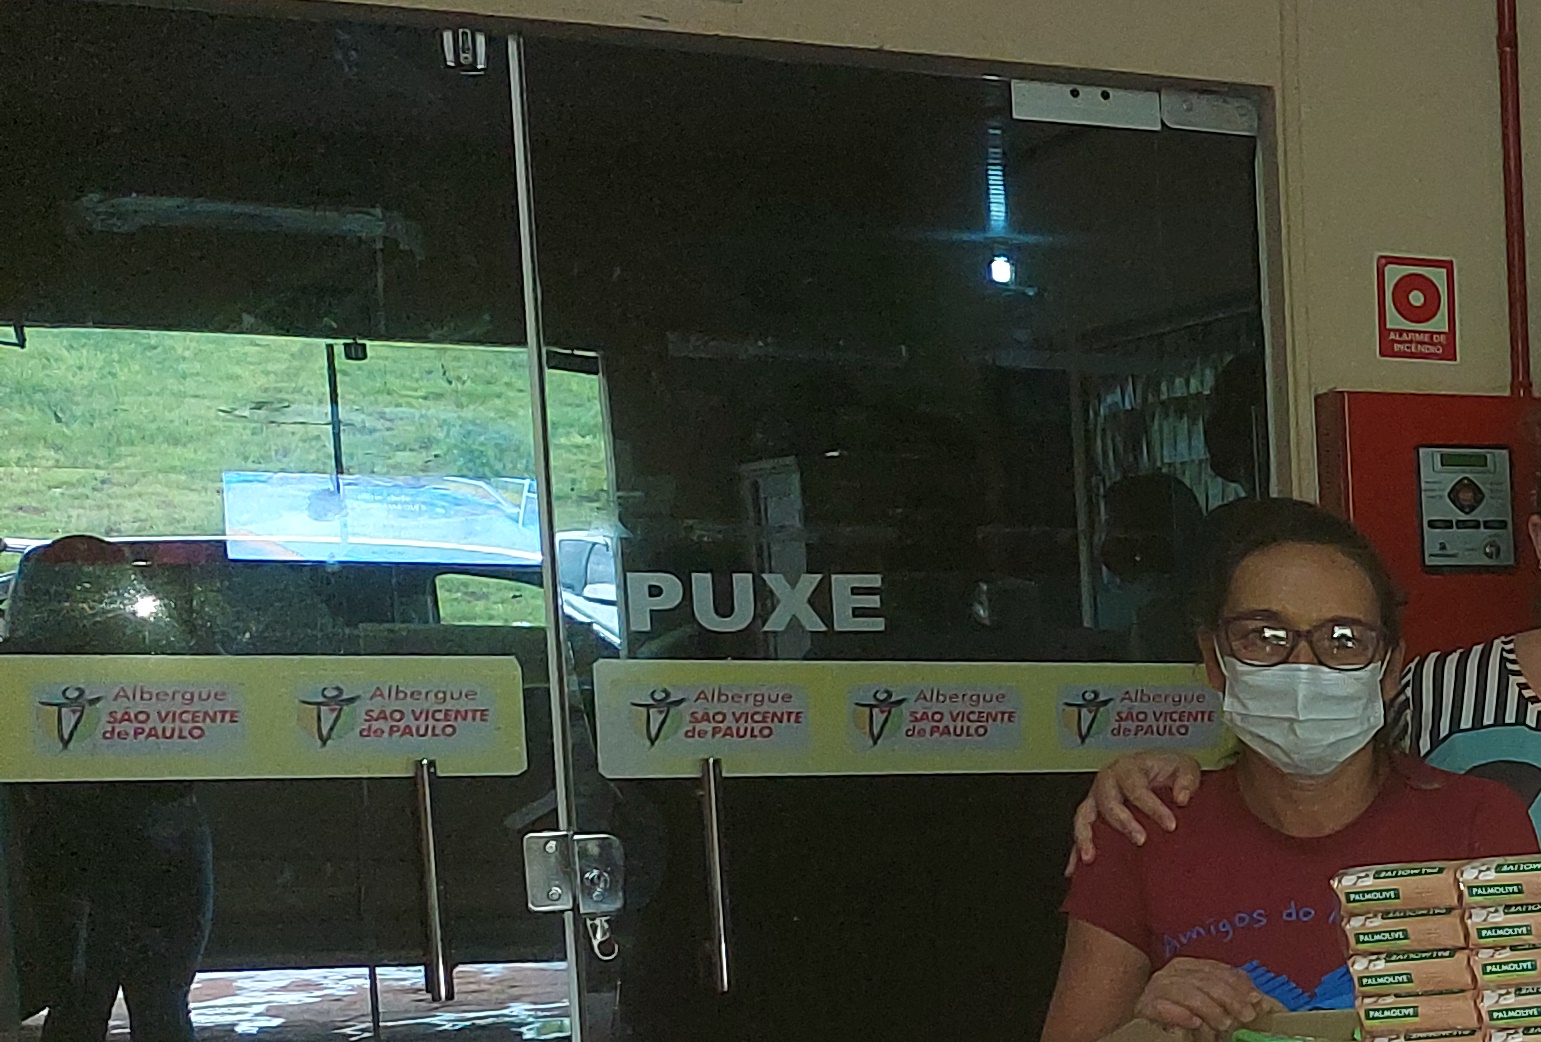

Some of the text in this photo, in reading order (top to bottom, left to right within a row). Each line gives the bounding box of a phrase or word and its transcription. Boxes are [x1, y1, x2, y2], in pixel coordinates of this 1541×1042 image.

[1389, 331, 1447, 343] ALARME DE
[1394, 343, 1443, 354] INCÊNDIO
[626, 573, 885, 632] PUXE
[113, 686, 227, 703] Albergue
[370, 686, 478, 703] Albergue
[694, 688, 793, 705] Albergue
[915, 688, 1006, 704] Albergue
[1121, 688, 1207, 704] Albergue
[157, 710, 239, 724] VICENTE
[410, 708, 488, 723] VICENTE
[730, 711, 803, 725] VICENTE
[948, 711, 1016, 724] VICENTE
[1151, 711, 1215, 724] VICENTE
[102, 725, 206, 741] de PAULO
[359, 724, 458, 739] de PAULO
[684, 725, 774, 740] de PAULO
[905, 724, 989, 739] de PAULO
[1111, 724, 1189, 738] de PAULO
[1350, 890, 1396, 900] PALMOLIVE
[1472, 886, 1520, 897] PALMOLIVE
[1164, 900, 1316, 959] Amigos do
[1359, 931, 1405, 942] PALMOLIVE
[1480, 926, 1528, 937] PALMOLIVE
[1485, 961, 1533, 973] PALMOLIVE
[1362, 975, 1408, 986] PALMOLIVE
[1368, 1008, 1415, 1019] PALMOLIVE
[1492, 1007, 1540, 1019] PALMOLIVE
